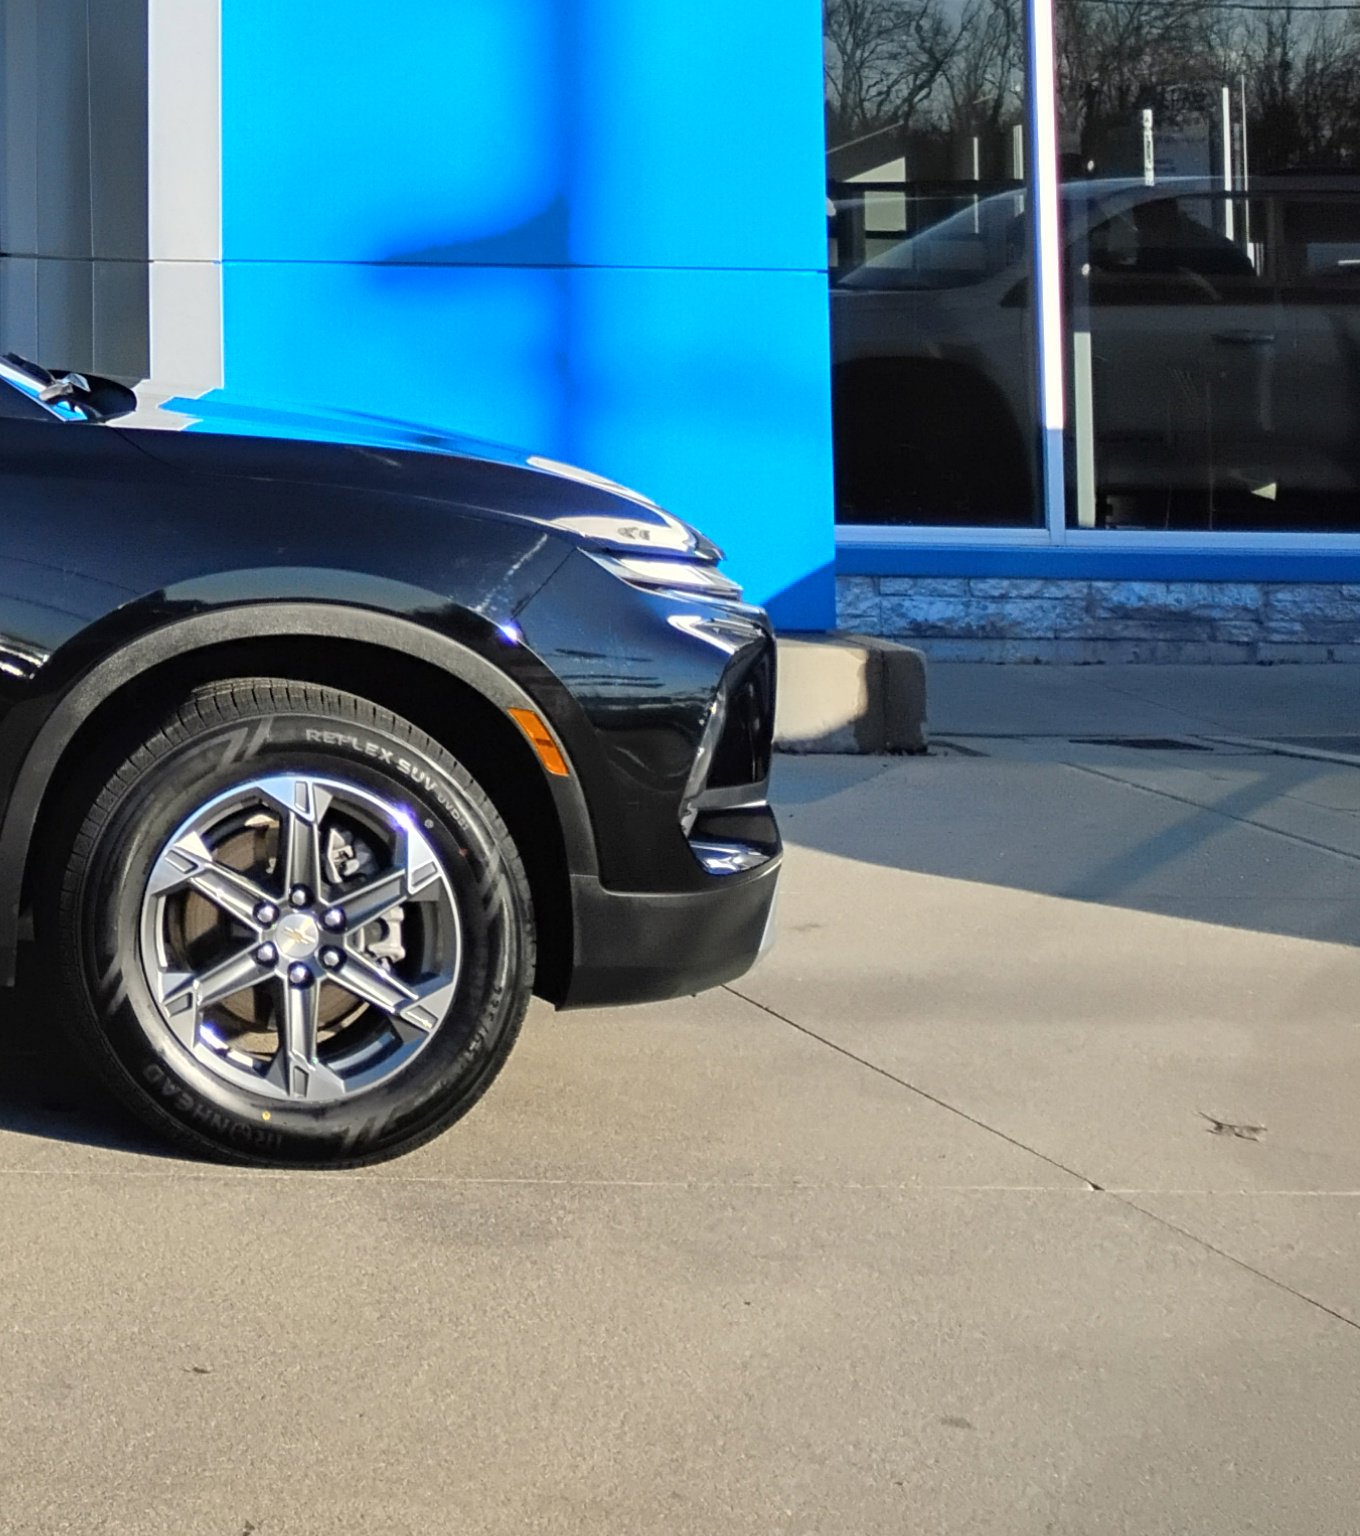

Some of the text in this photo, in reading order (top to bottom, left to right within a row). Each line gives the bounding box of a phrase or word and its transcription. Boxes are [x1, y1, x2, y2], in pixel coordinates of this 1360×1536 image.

[305, 728, 394, 765] REFLEX
[396, 758, 438, 792] SUV
[143, 1063, 282, 1146] IRONHEAD
